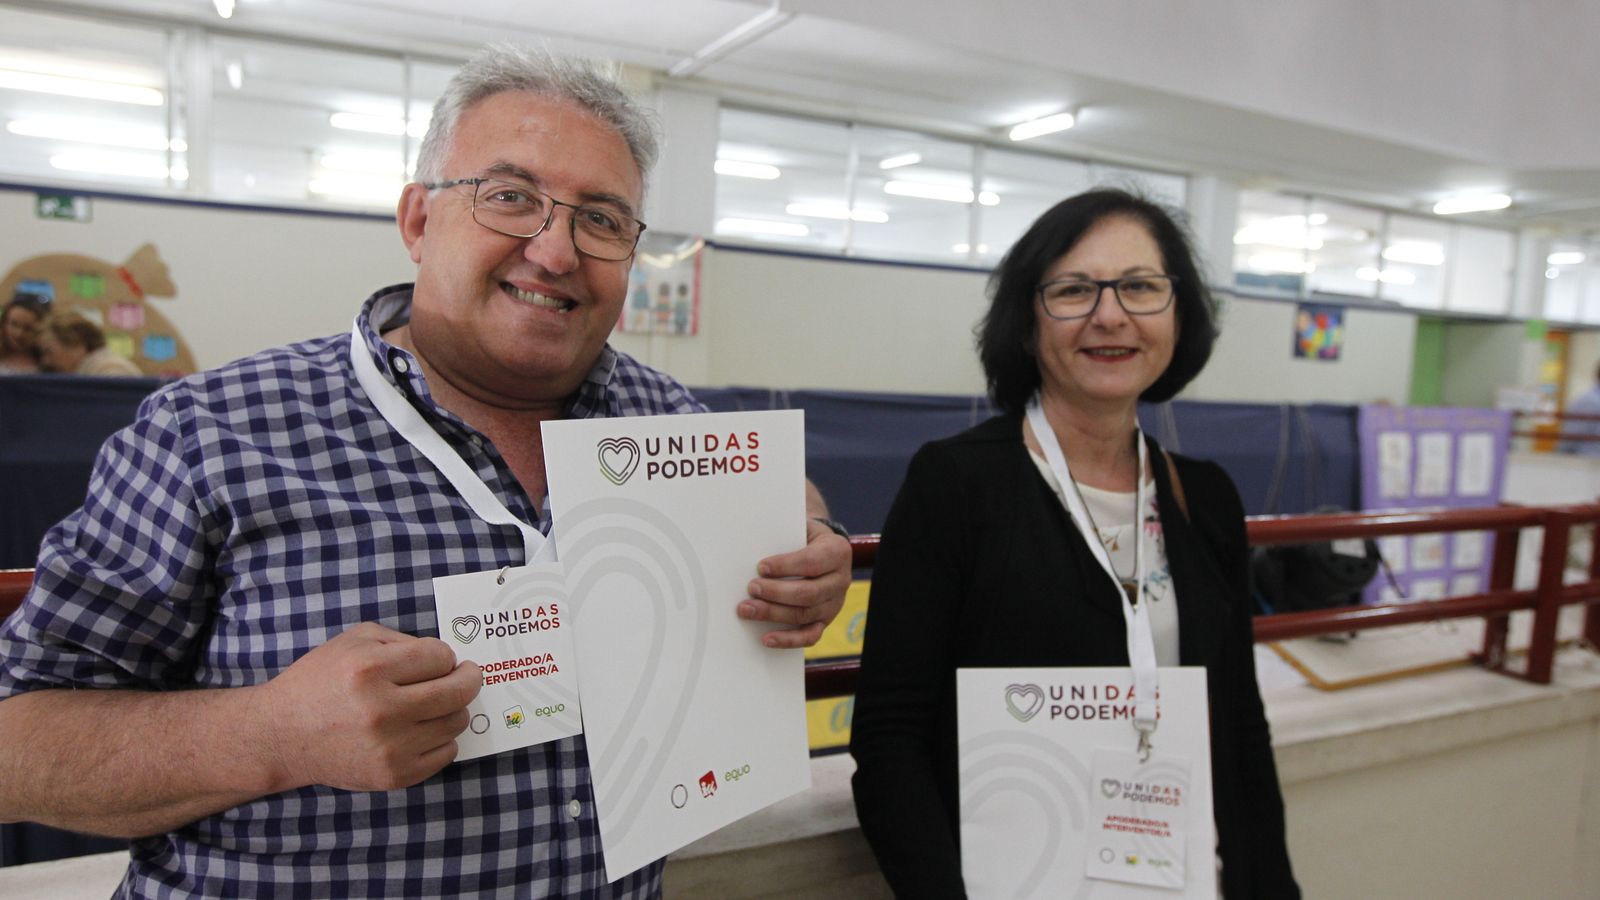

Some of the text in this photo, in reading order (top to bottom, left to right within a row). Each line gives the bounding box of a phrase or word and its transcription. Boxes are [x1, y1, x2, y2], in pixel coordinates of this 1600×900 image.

[645, 431, 759, 457] UNIDAS
[646, 454, 760, 481] PODEMOS
[483, 603, 559, 625] UNIDAS
[485, 617, 561, 640] PODEMOS
[478, 653, 554, 674] PODERADO/A
[481, 664, 559, 687] TERVENTOR/A
[535, 703, 565, 717] equo
[1122, 792, 1181, 807] PODEMOS
[1123, 782, 1182, 796] UNIDAS
